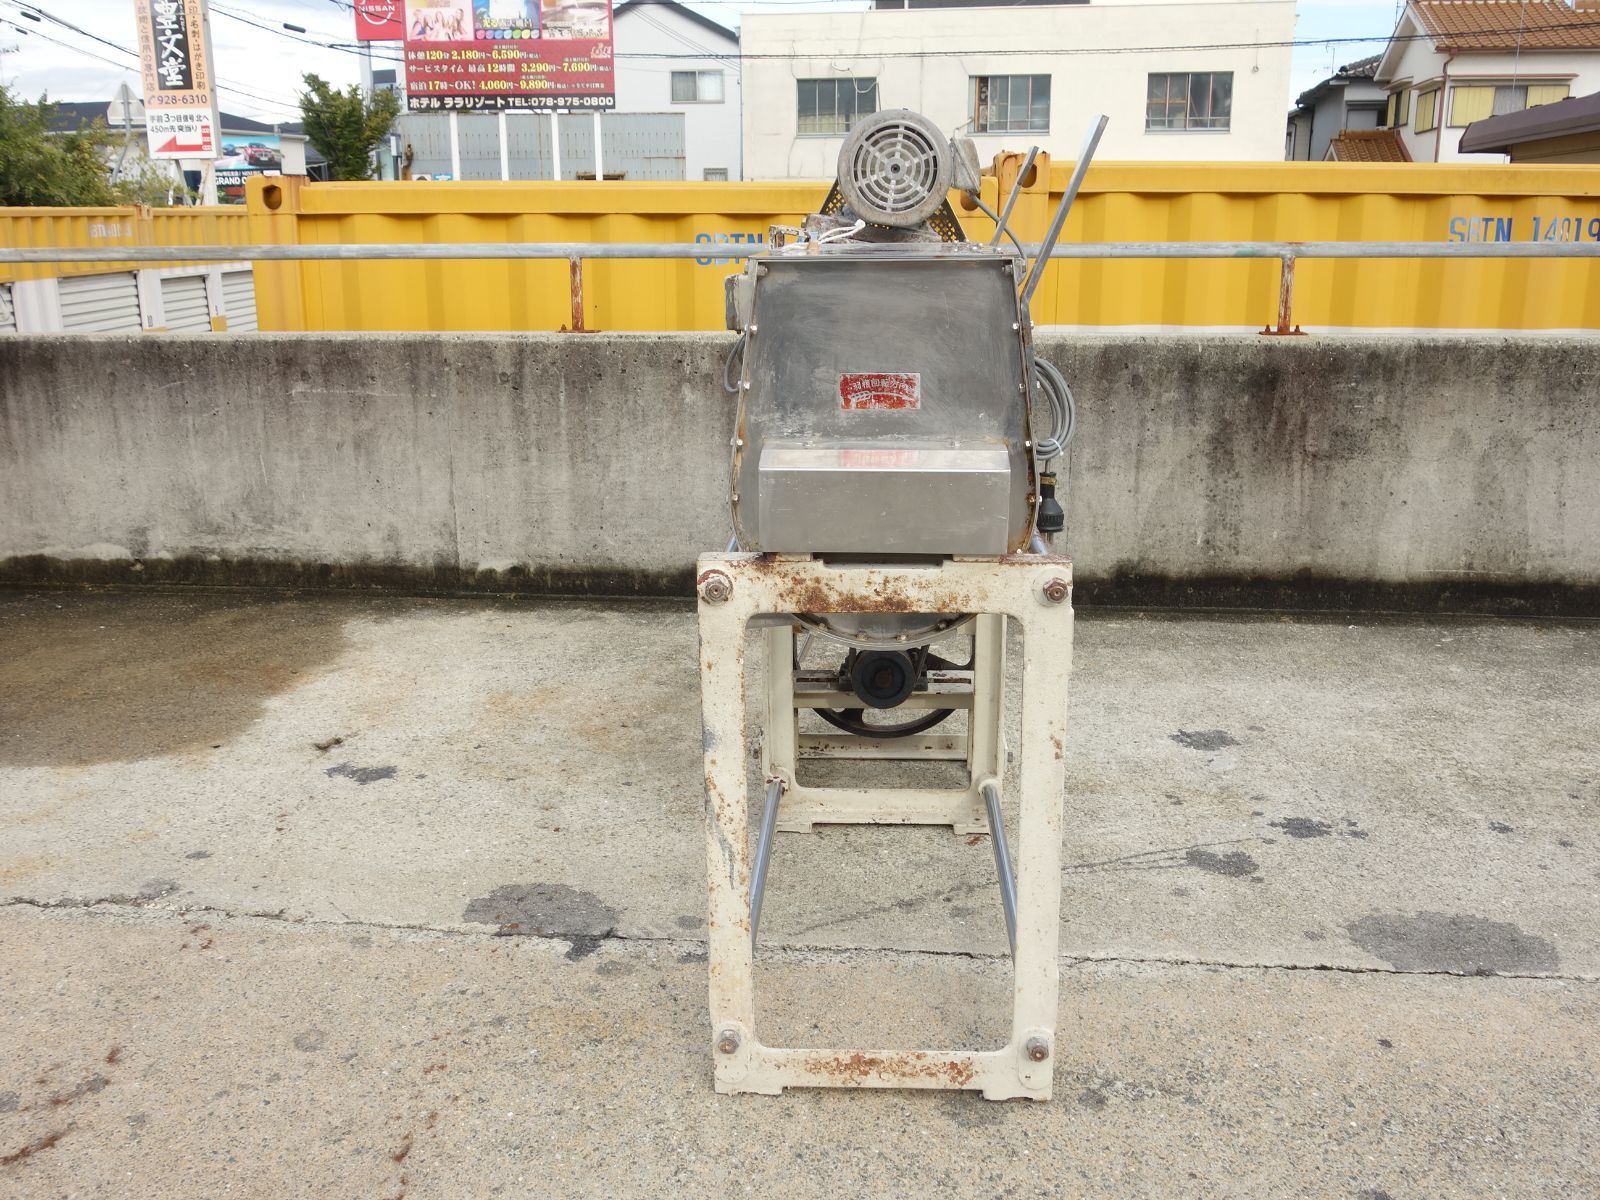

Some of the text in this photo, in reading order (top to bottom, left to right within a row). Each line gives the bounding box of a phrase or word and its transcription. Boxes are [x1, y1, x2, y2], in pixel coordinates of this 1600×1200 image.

[409, 63, 464, 73] サービスタイム
[157, 94, 208, 105] 928-6310
[410, 97, 440, 109] ホテル
[444, 96, 505, 108] ララリゾート
